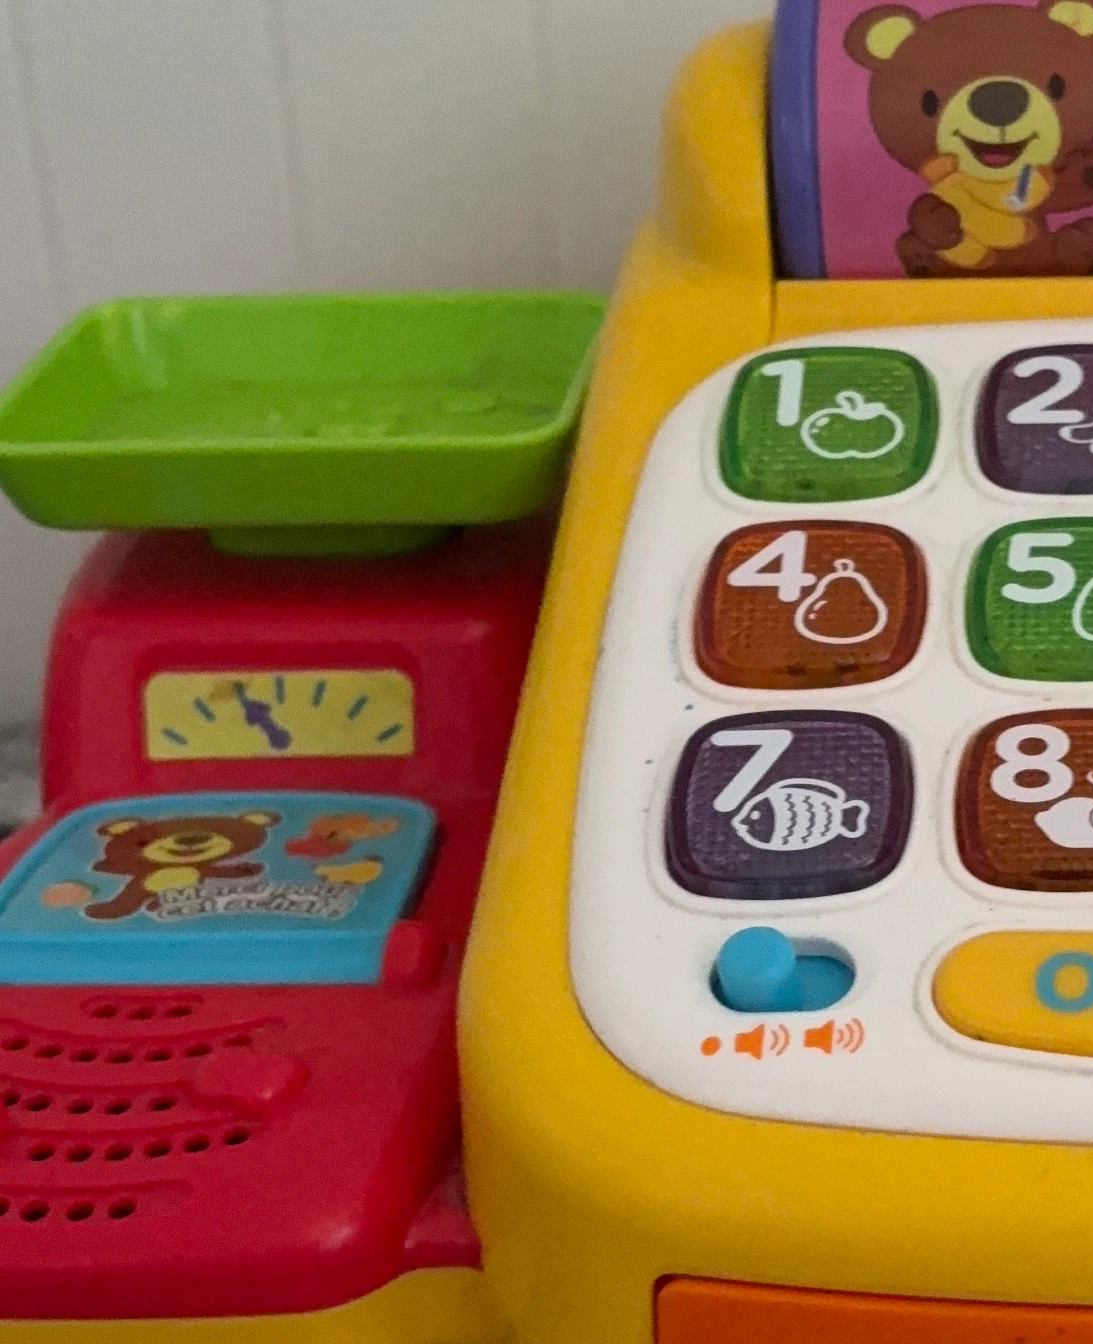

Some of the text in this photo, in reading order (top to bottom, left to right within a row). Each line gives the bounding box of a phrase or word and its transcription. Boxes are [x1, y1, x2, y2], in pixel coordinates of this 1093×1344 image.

[762, 359, 804, 426] 1
[1008, 356, 1085, 424] 2
[727, 530, 816, 602] 4
[1002, 532, 1076, 604] 5
[710, 729, 793, 813] 7
[990, 723, 1073, 803] 8
